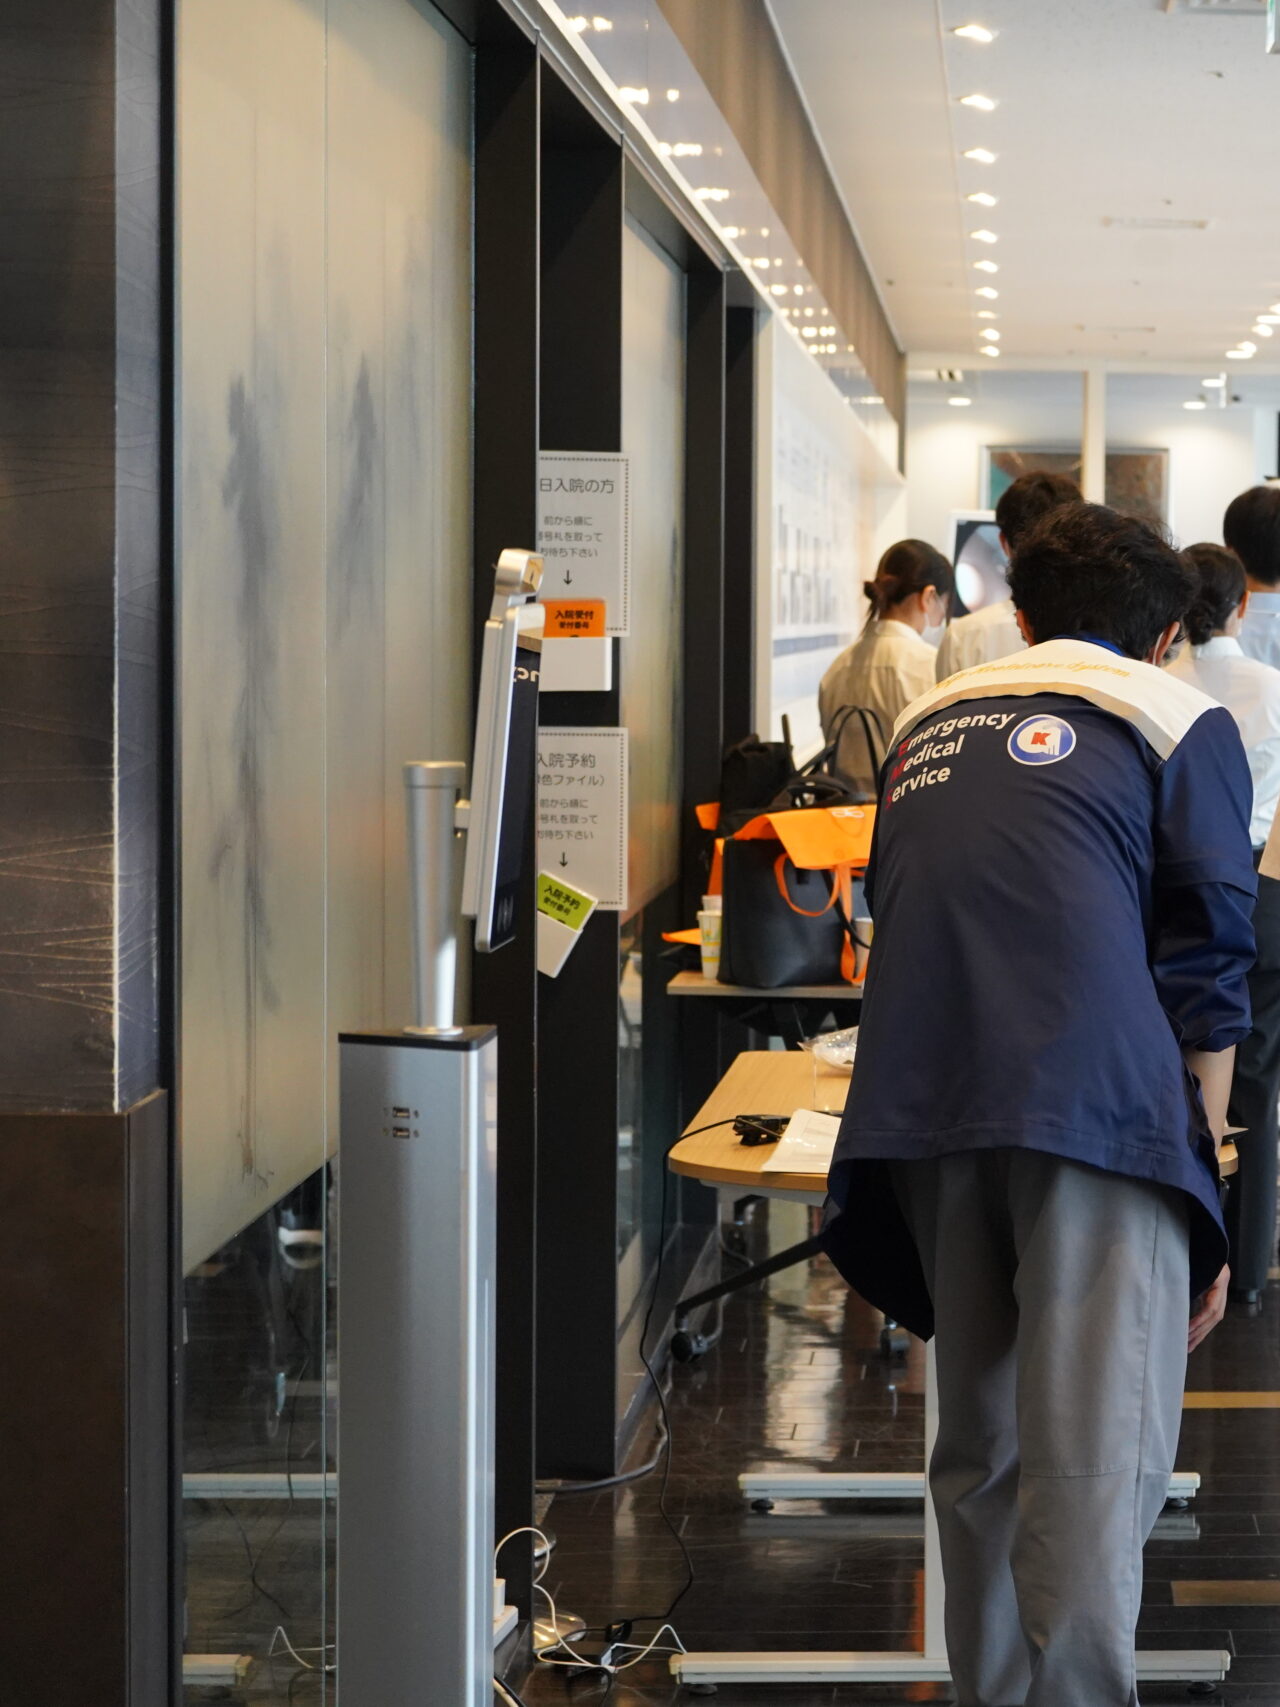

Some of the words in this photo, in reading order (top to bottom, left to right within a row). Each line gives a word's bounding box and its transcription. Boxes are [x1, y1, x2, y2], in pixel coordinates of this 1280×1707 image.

[540, 478, 615, 493] 日入院の方
[555, 610, 594, 620] 入院受付
[898, 712, 1017, 757] Emergency
[537, 753, 596, 768] 入院予約
[890, 734, 965, 784] Medical
[885, 766, 951, 811] Service
